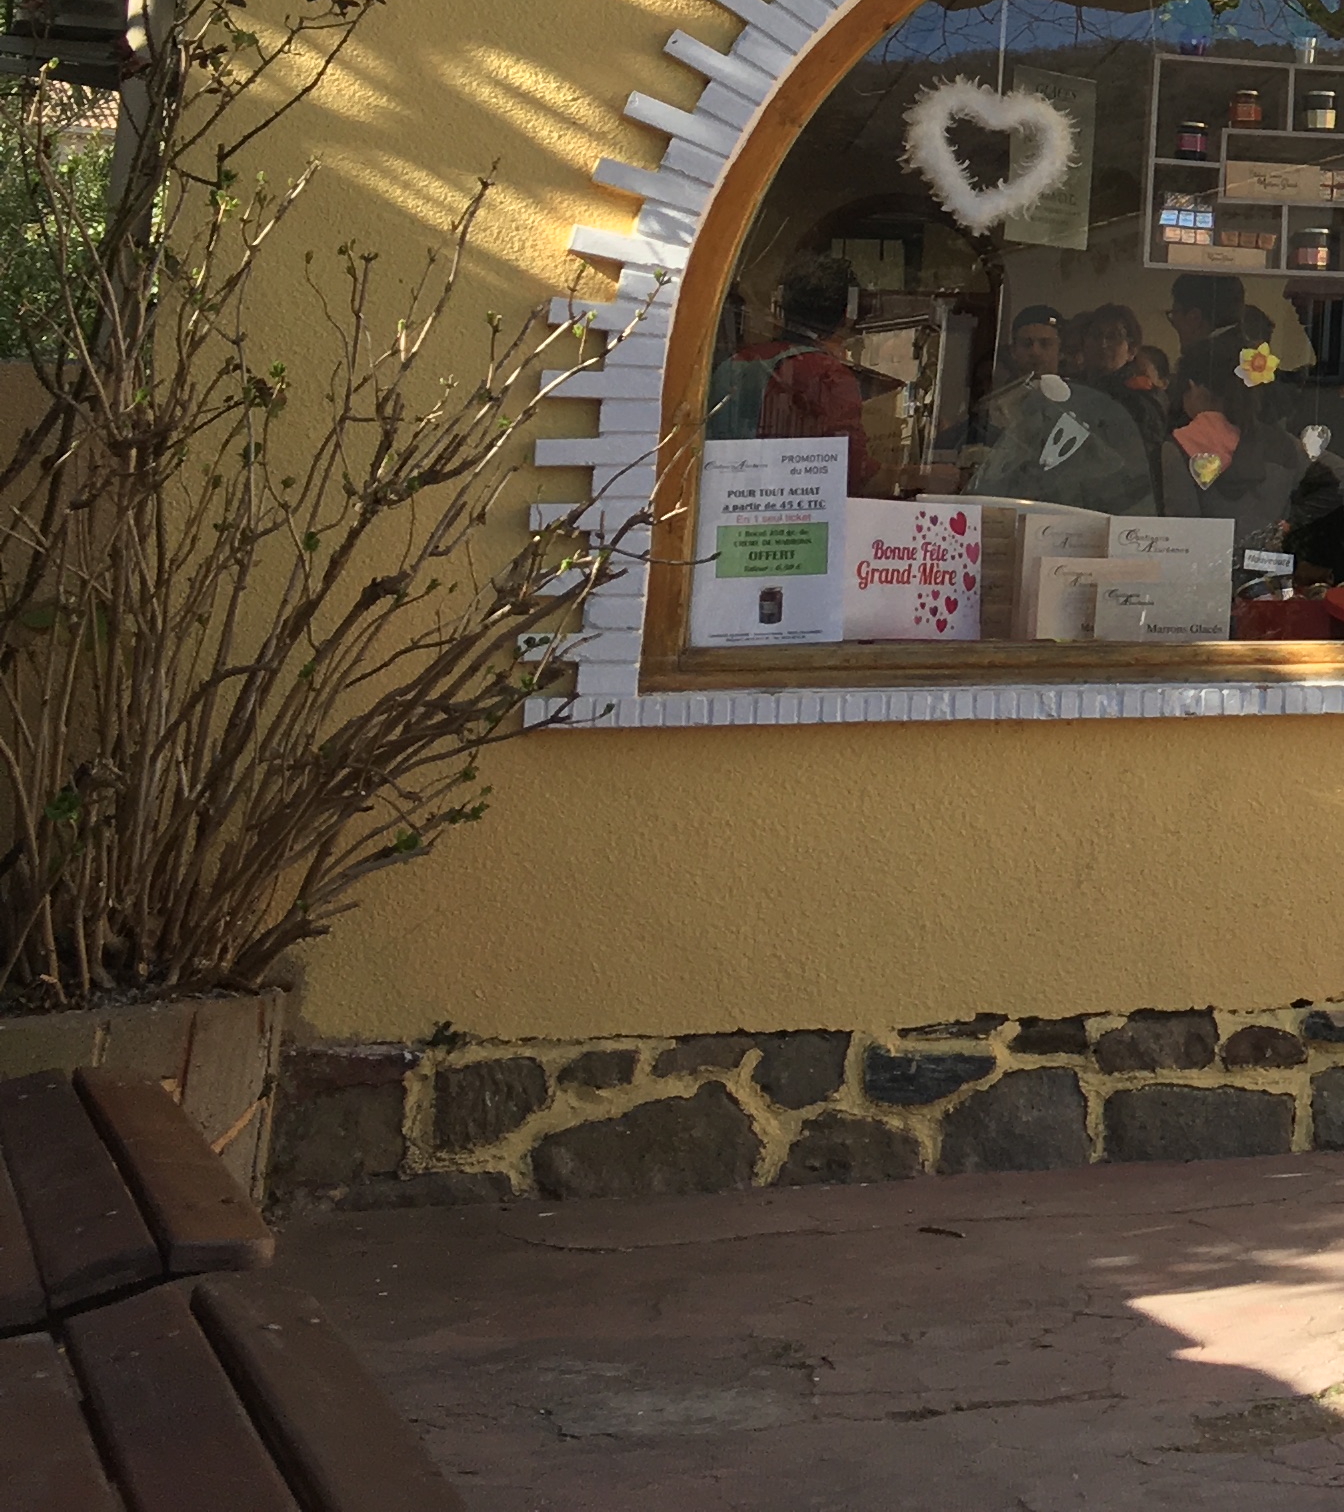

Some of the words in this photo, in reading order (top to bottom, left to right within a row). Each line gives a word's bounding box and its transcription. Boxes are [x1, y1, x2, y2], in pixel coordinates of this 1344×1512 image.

[781, 453, 839, 464] PROMOTION
[803, 465, 829, 476] MOIS
[727, 489, 756, 499] POUR
[759, 488, 784, 498] TOUT
[788, 486, 821, 497] ACHAT
[748, 549, 796, 562] OFFERT
[871, 539, 918, 561] Bonne
[856, 560, 958, 591] Grand-Mère
[1146, 624, 1188, 635] Marrons
